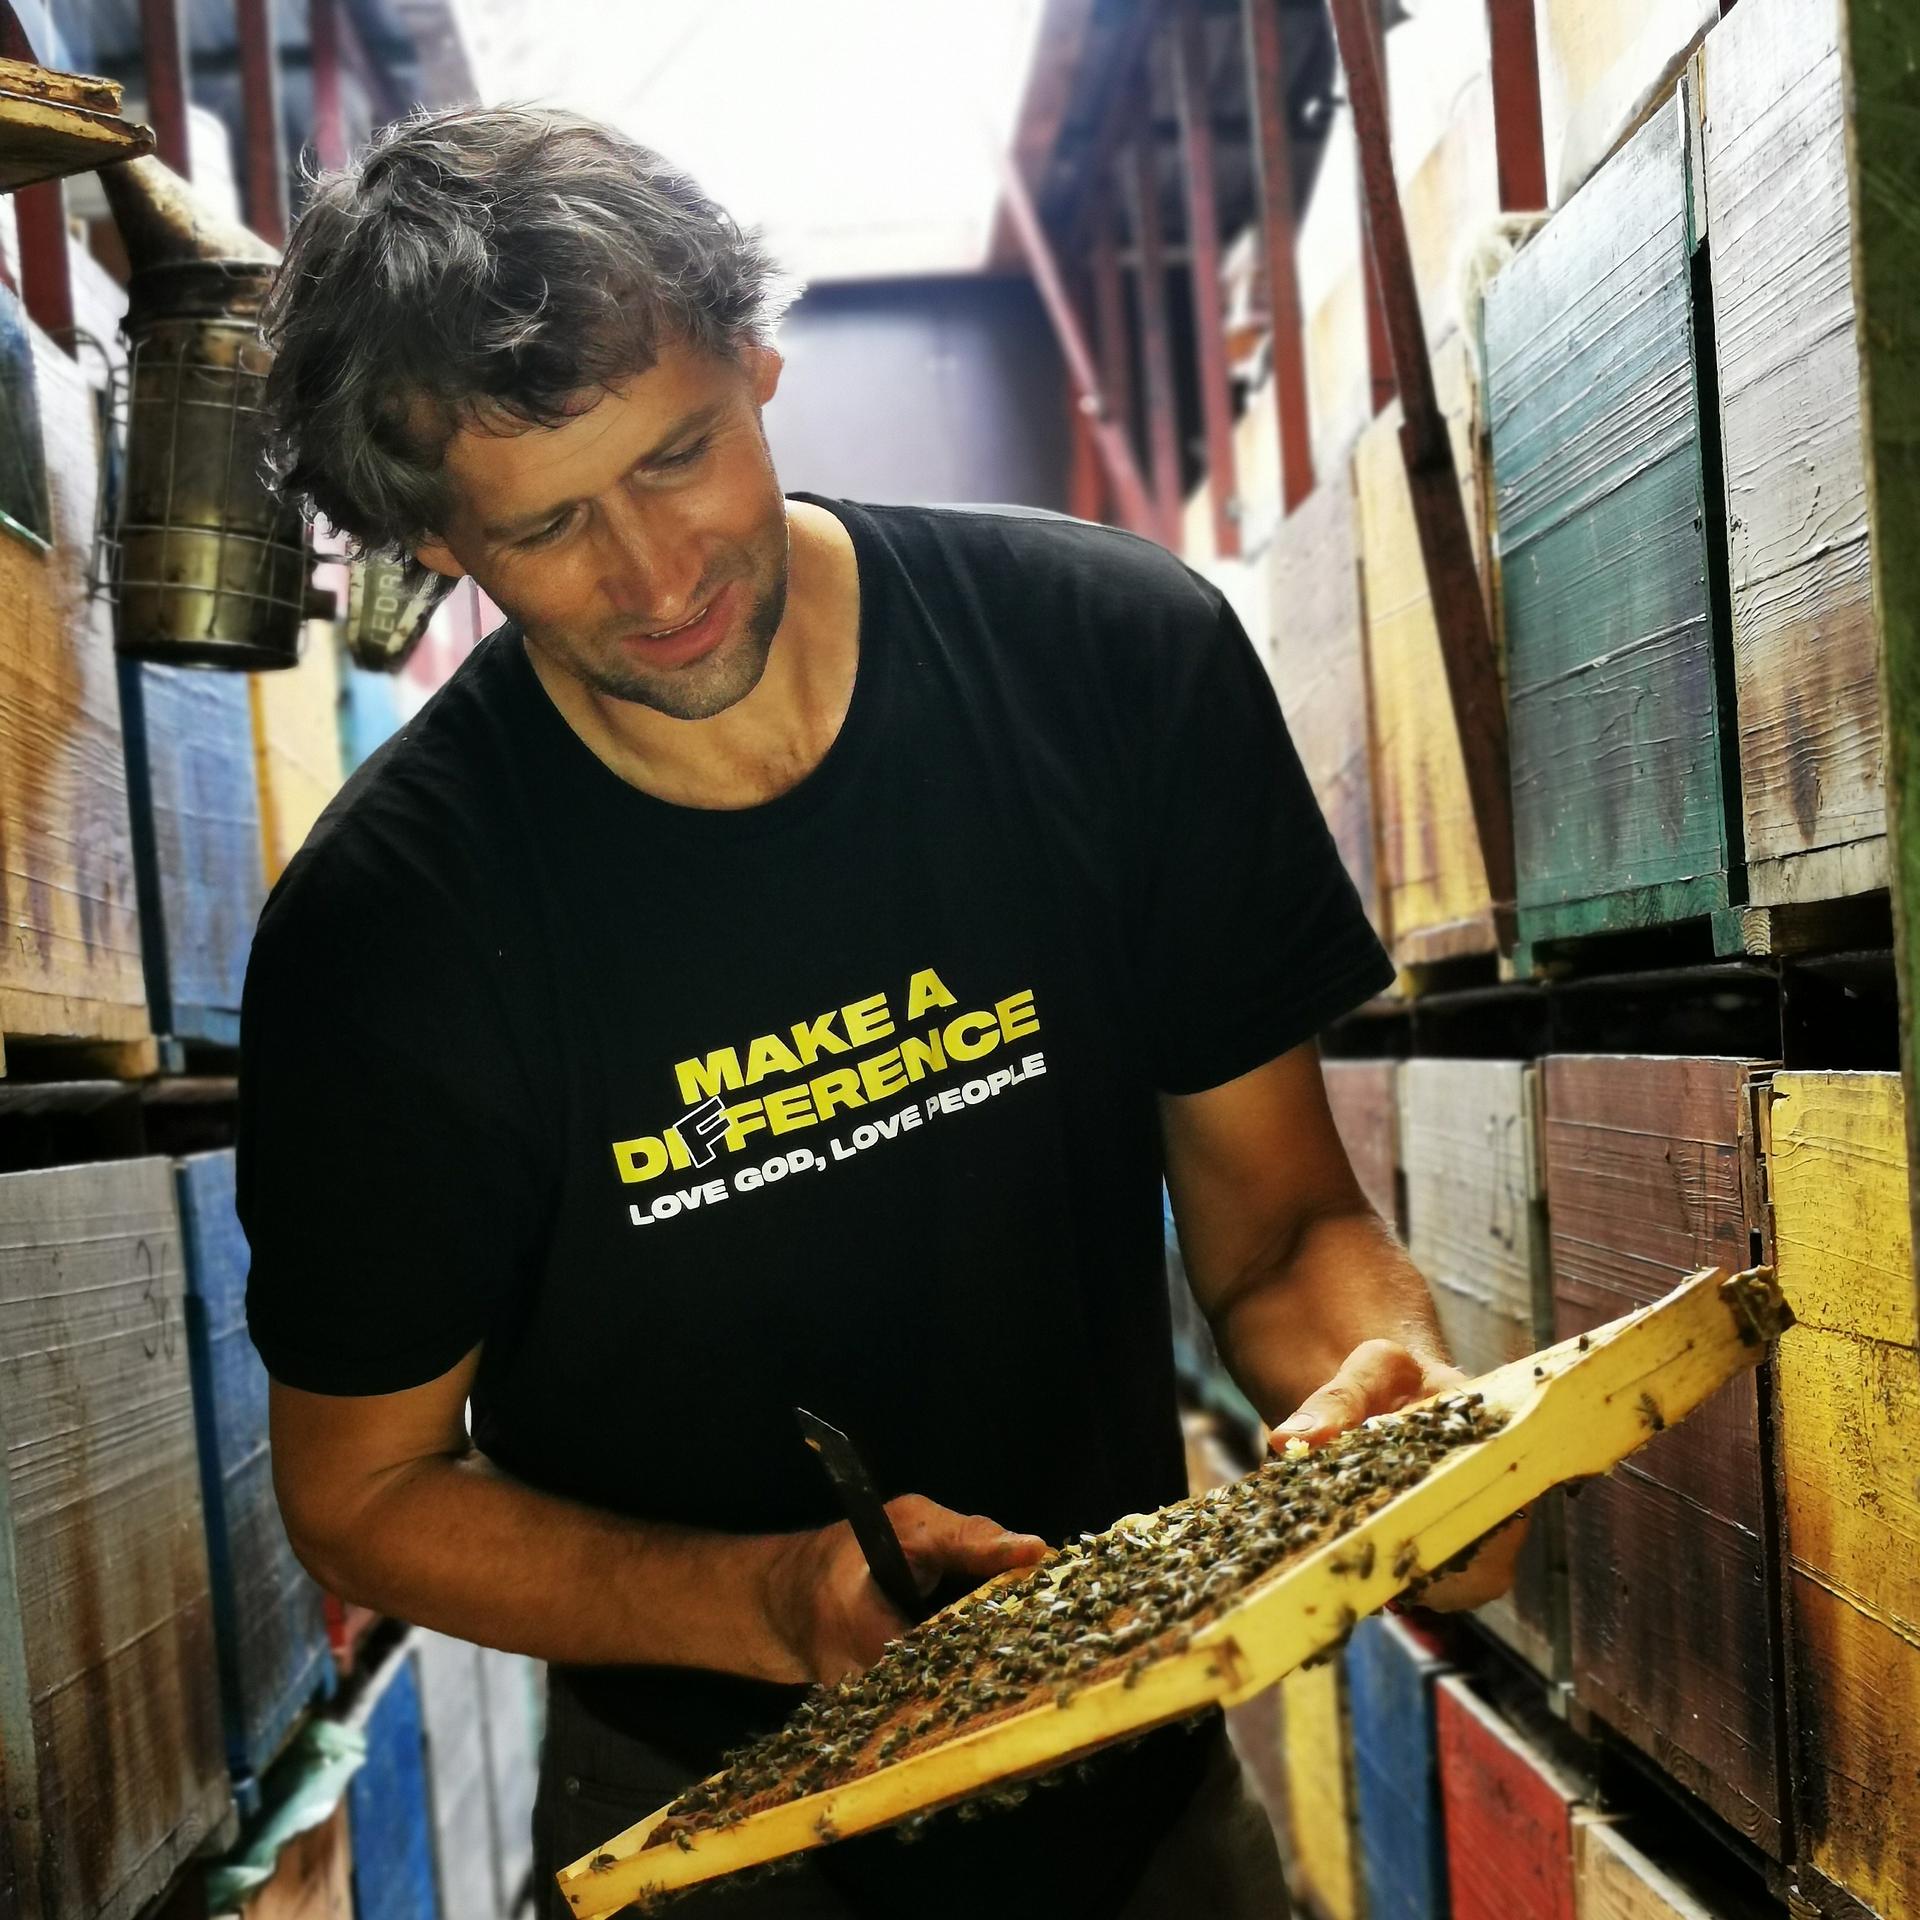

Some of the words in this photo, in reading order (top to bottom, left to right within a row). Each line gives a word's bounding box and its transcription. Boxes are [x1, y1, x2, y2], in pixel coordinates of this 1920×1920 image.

[612, 988, 1041, 1184] DIFFERENCE
[674, 992, 897, 1106] MAKE
[907, 967, 958, 1021] A
[629, 1178, 730, 1226] LOVE
[734, 1148, 827, 1192] GOD,
[829, 1105, 924, 1161] LOVE
[928, 1052, 1047, 1121] PEOPLE
